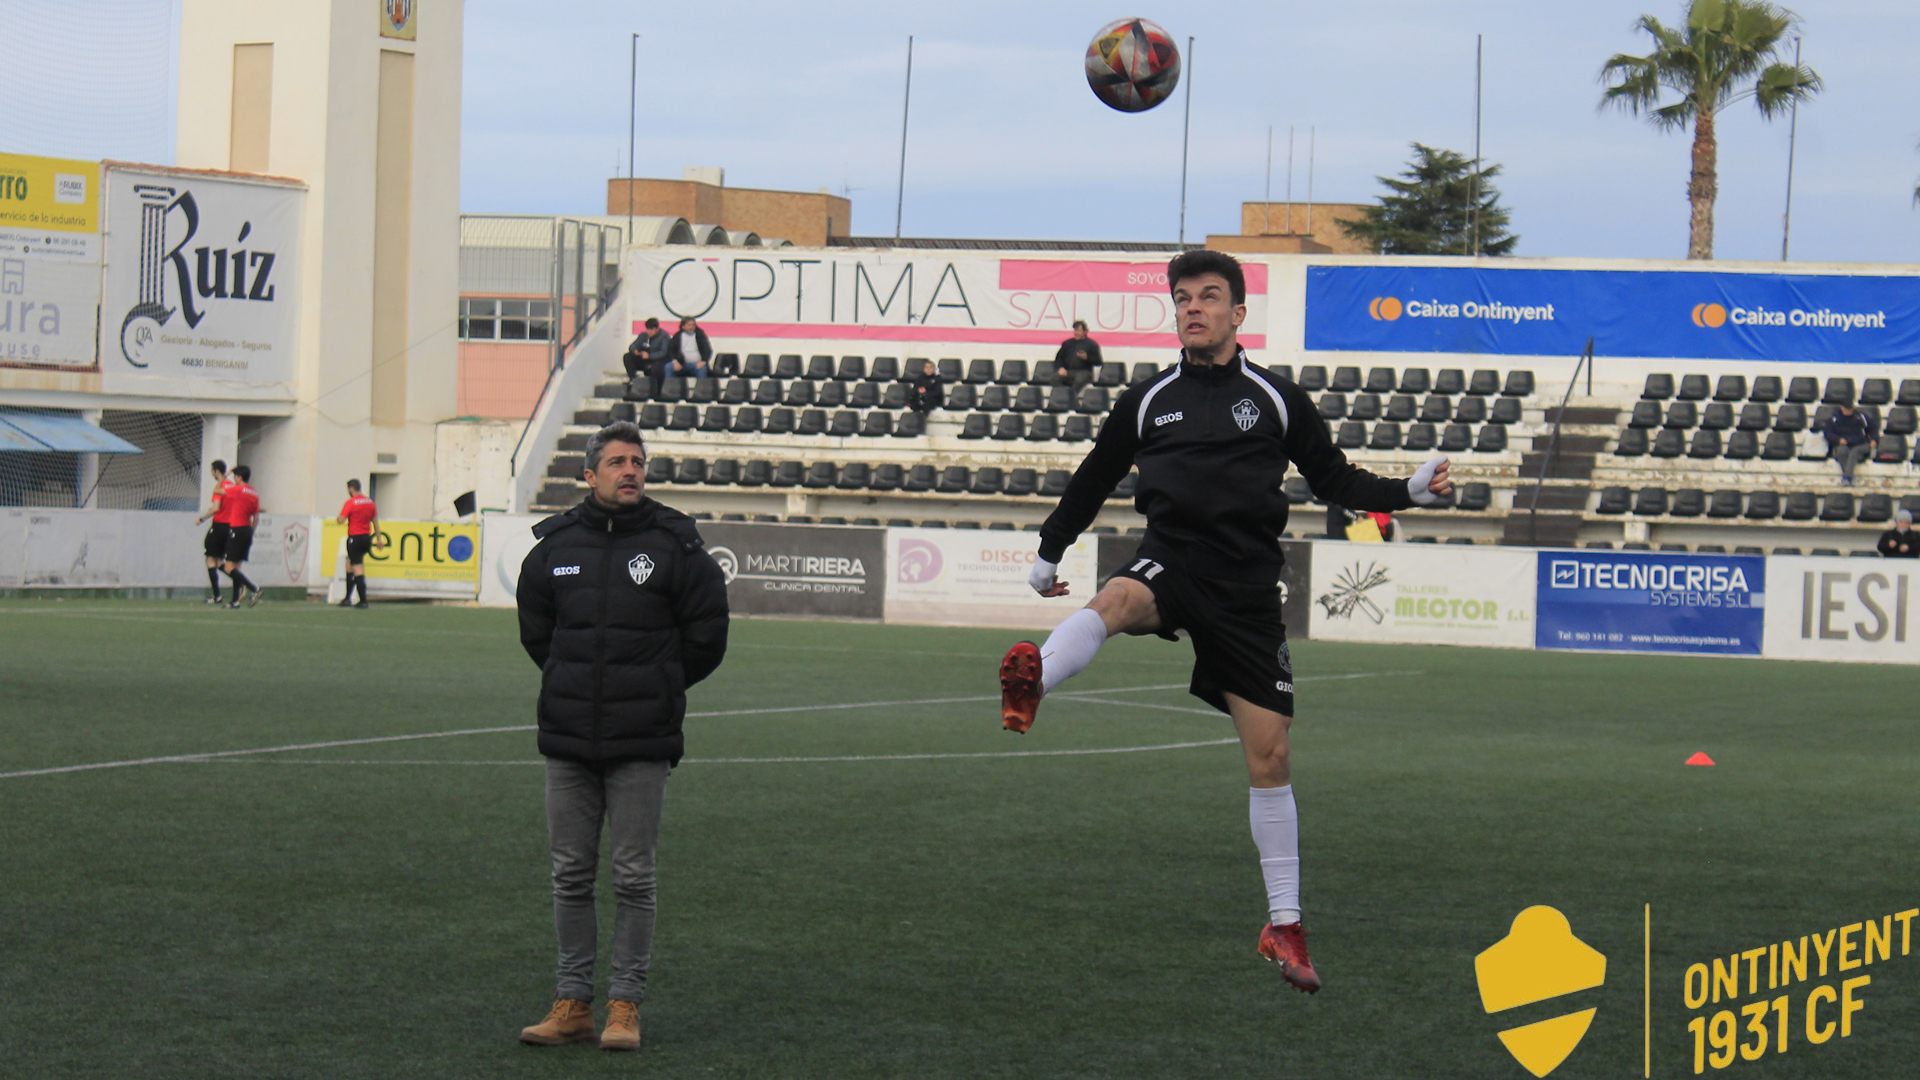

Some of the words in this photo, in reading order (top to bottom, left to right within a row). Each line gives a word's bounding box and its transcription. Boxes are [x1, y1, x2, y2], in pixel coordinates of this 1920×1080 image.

[51, 214, 86, 226] industria
[1406, 298, 1460, 318] Caixa
[1462, 301, 1555, 324] Ontinyent
[1731, 306, 1786, 326] Caixa
[1790, 308, 1886, 332] Ontinyent
[200, 337, 235, 349] Abogados
[242, 340, 272, 352] Seguros
[181, 358, 204, 367] 46830
[1154, 411, 1184, 426] GIOS
[981, 549, 1038, 564] DISCO
[553, 565, 580, 576] GIOS
[746, 554, 866, 576] MARTIRIERA
[958, 564, 1023, 572] TECHNOLOGY
[1130, 558, 1164, 580] 11
[1582, 563, 1749, 592] TECNOCRISA
[814, 584, 866, 594] DENTAL
[1396, 584, 1449, 594] TALLERES
[1651, 590, 1722, 607] SYSTEMS
[1395, 596, 1498, 620] MECTOR
[1801, 571, 1908, 643] IESI
